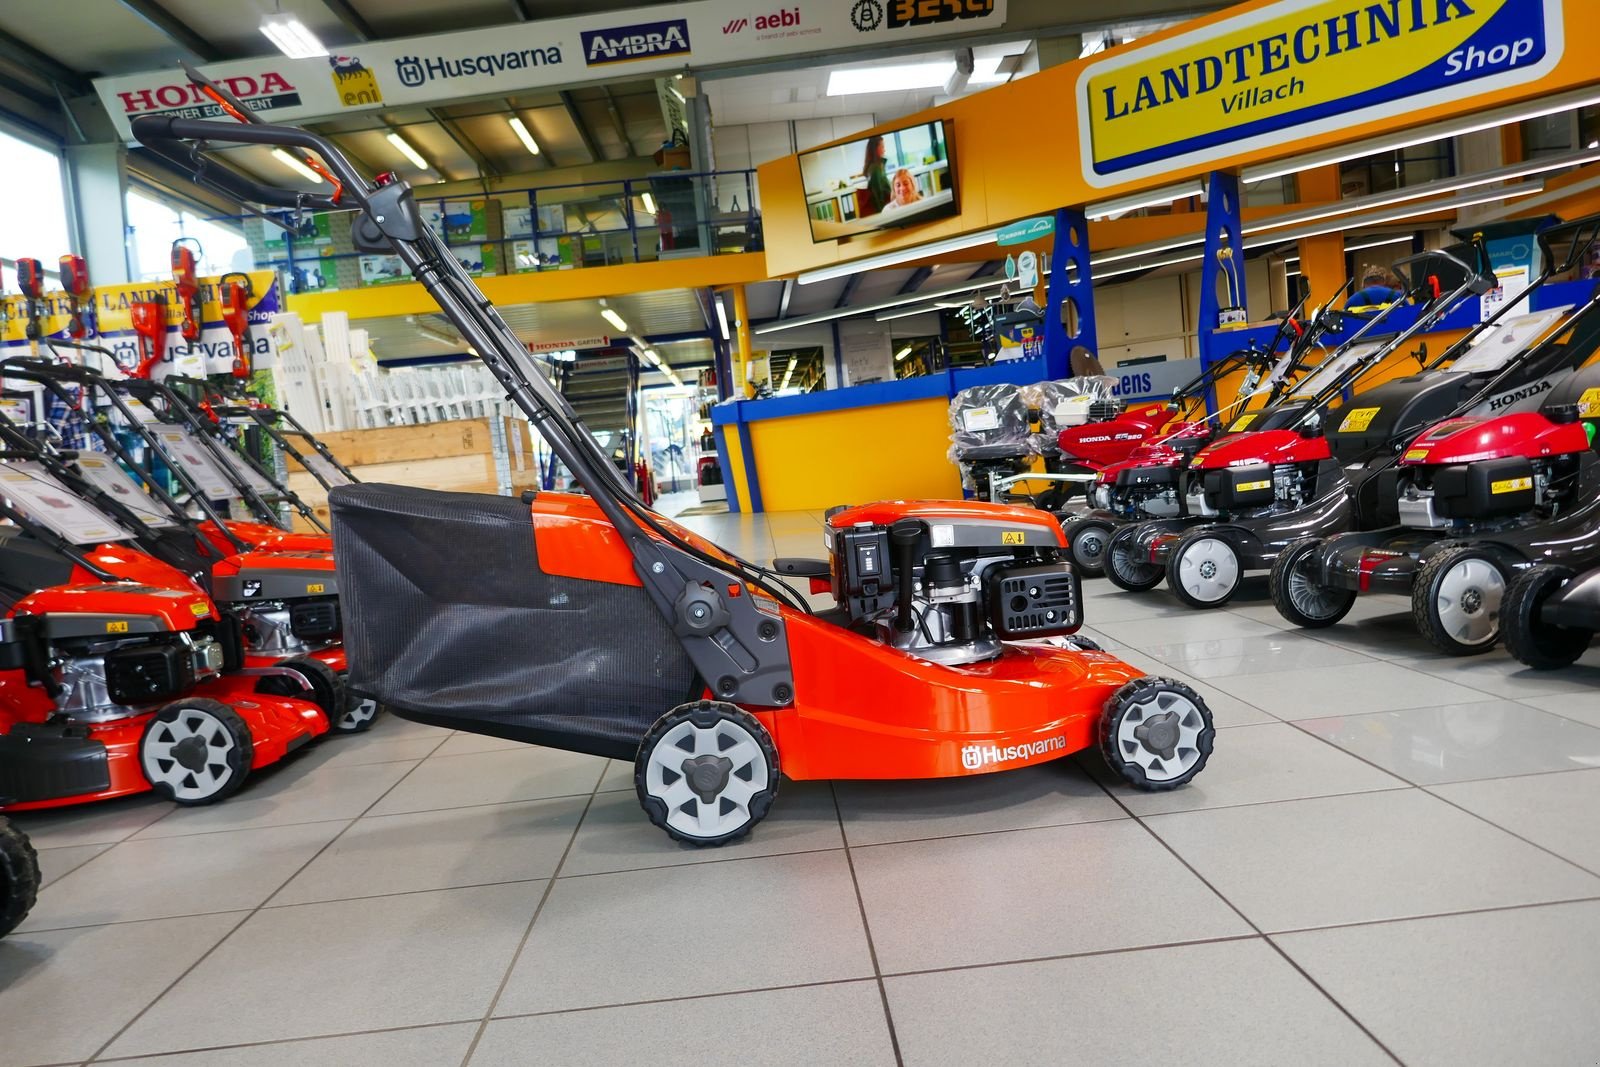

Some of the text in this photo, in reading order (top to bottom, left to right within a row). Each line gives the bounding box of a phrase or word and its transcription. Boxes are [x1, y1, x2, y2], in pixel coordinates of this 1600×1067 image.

[755, 8, 800, 30] aebi
[589, 26, 687, 60] AMBRA
[1444, 36, 1535, 77] Shop
[424, 46, 562, 80] Husqvarna
[1102, 0, 1476, 121] LANDTECHNIK
[157, 98, 273, 120] OWER EQENT
[344, 83, 379, 106] eni
[1221, 76, 1305, 115] Villach
[536, 338, 602, 350] HONDA GARTEN
[1490, 381, 1552, 411] HONDA
[1079, 435, 1111, 443] HONDA
[982, 735, 1066, 764] Husqvarna
